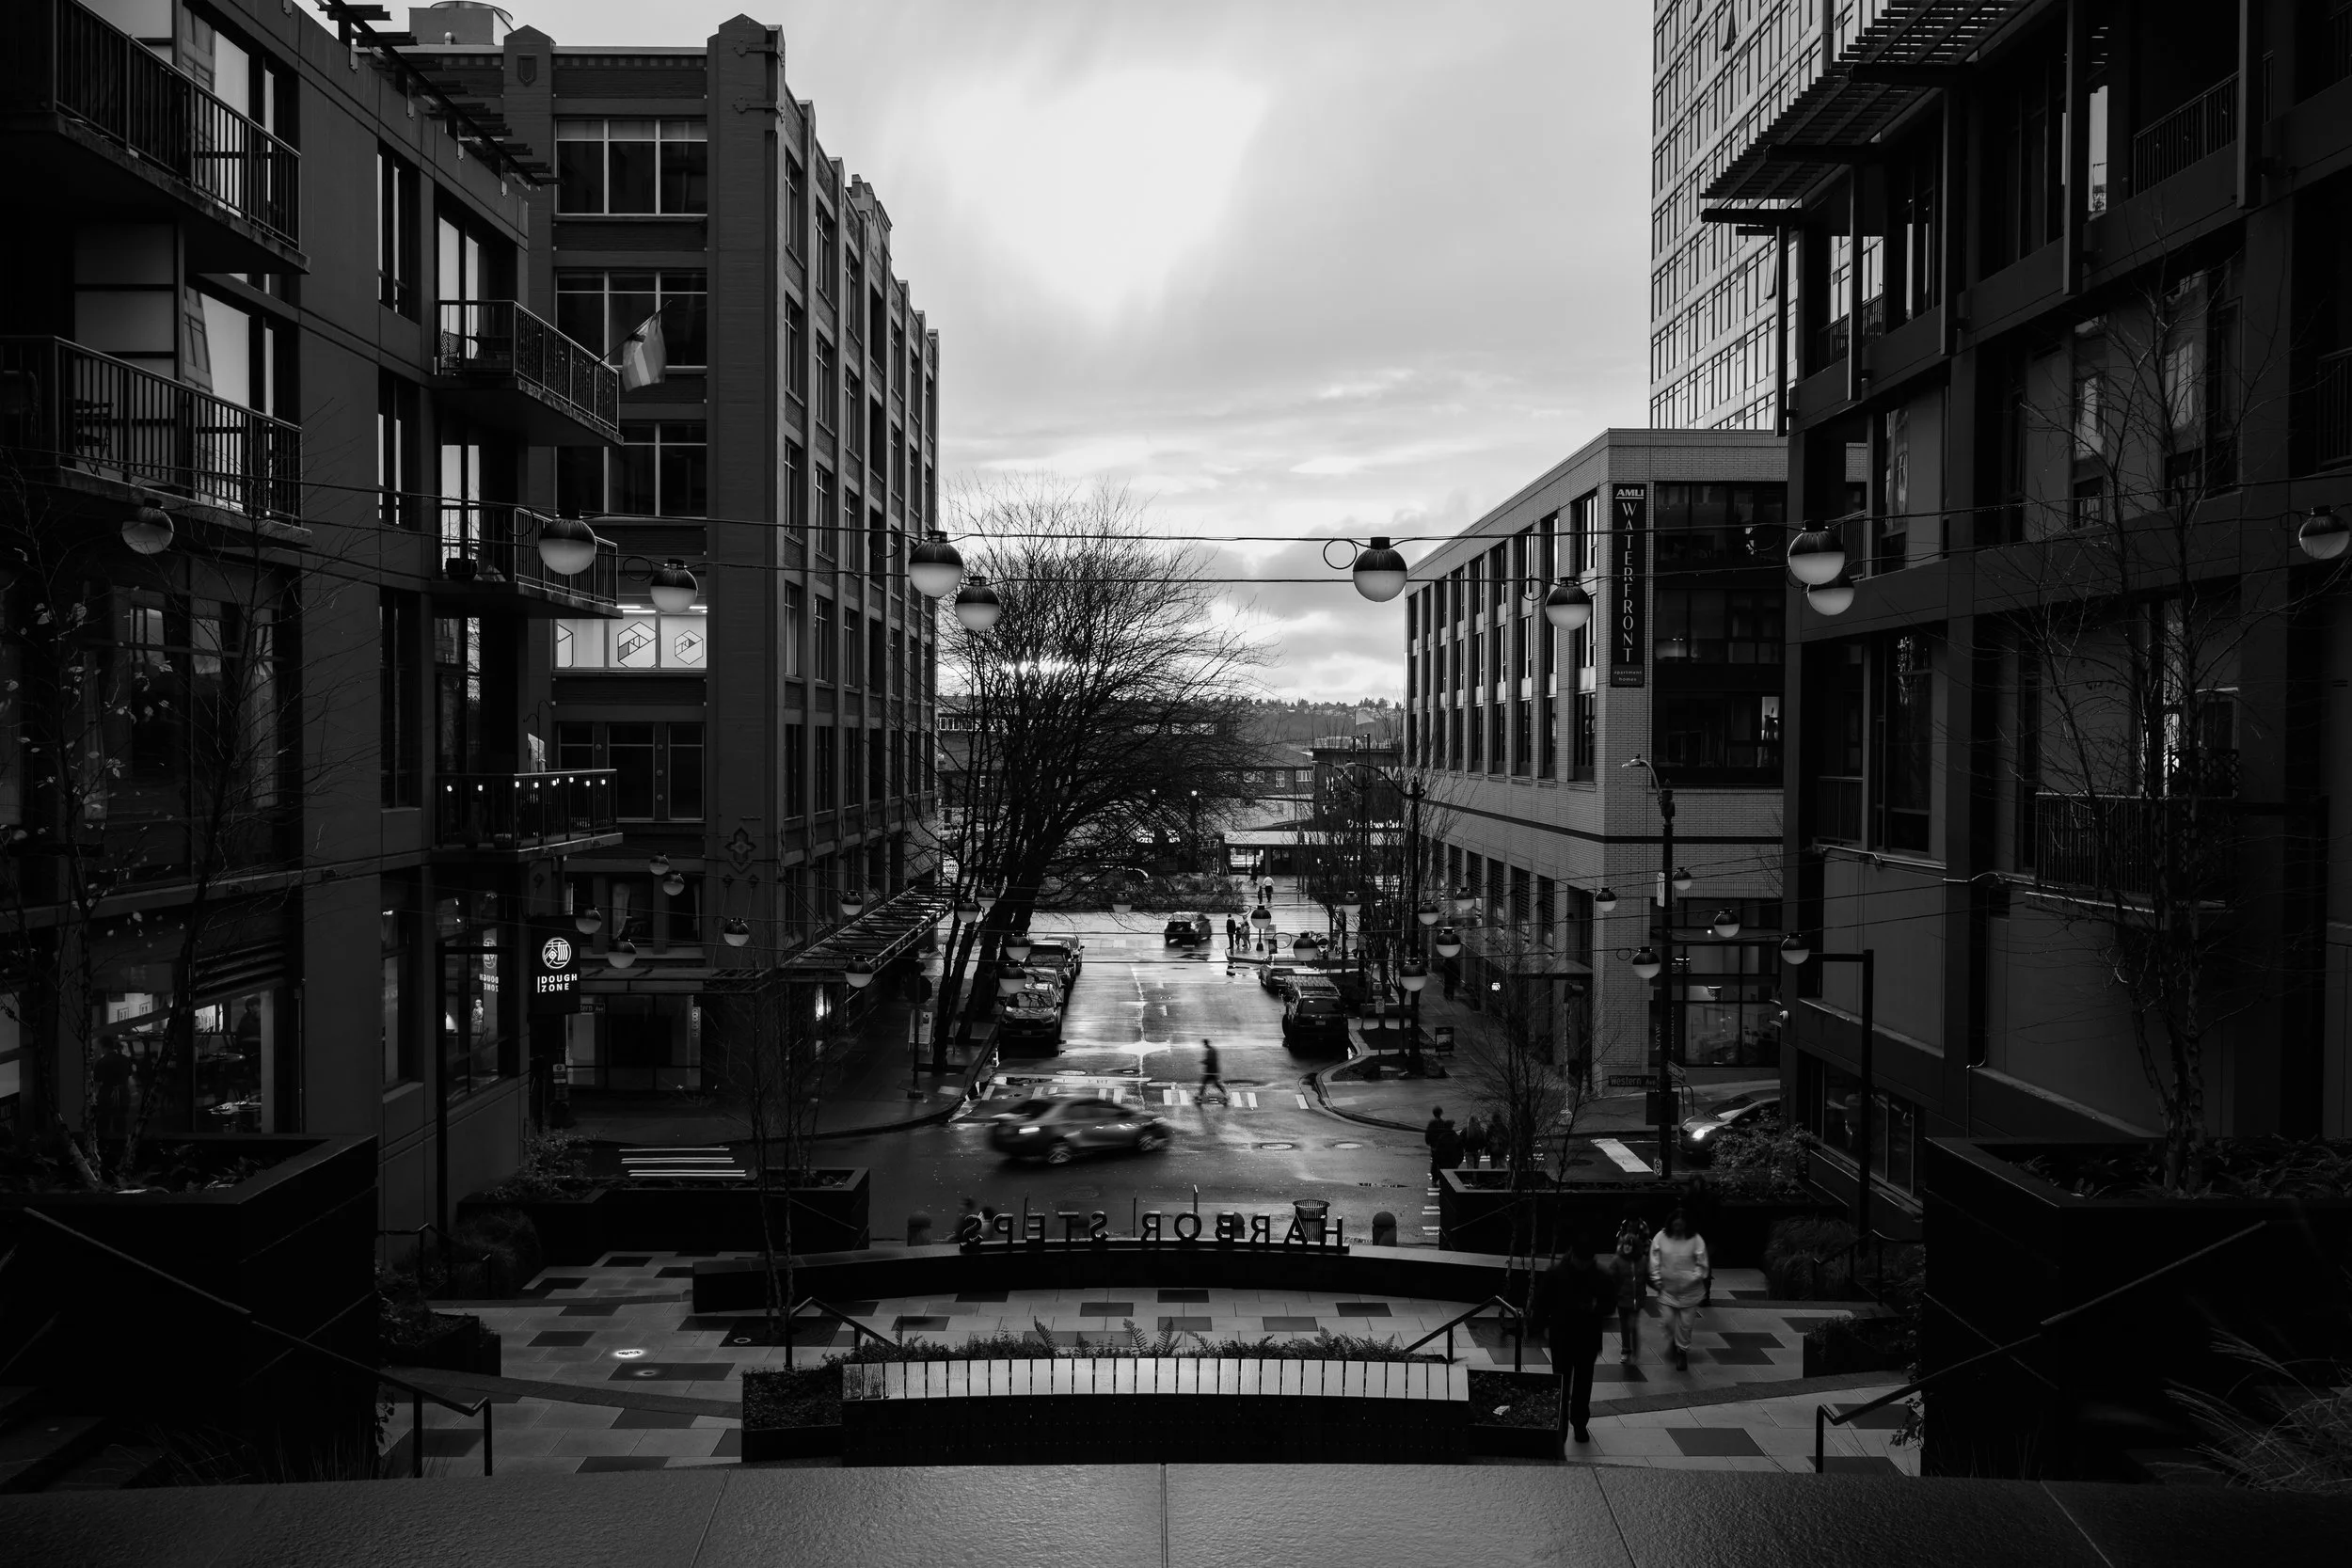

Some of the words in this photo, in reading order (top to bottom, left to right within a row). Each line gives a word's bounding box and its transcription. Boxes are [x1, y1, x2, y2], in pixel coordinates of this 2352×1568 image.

[1616, 488, 1645, 497] AMLI
[1621, 501, 1638, 663] WATERFRONT
[541, 973, 578, 985] DOUGH
[541, 982, 570, 993] ZONE
[1610, 1076, 1642, 1086] Western
